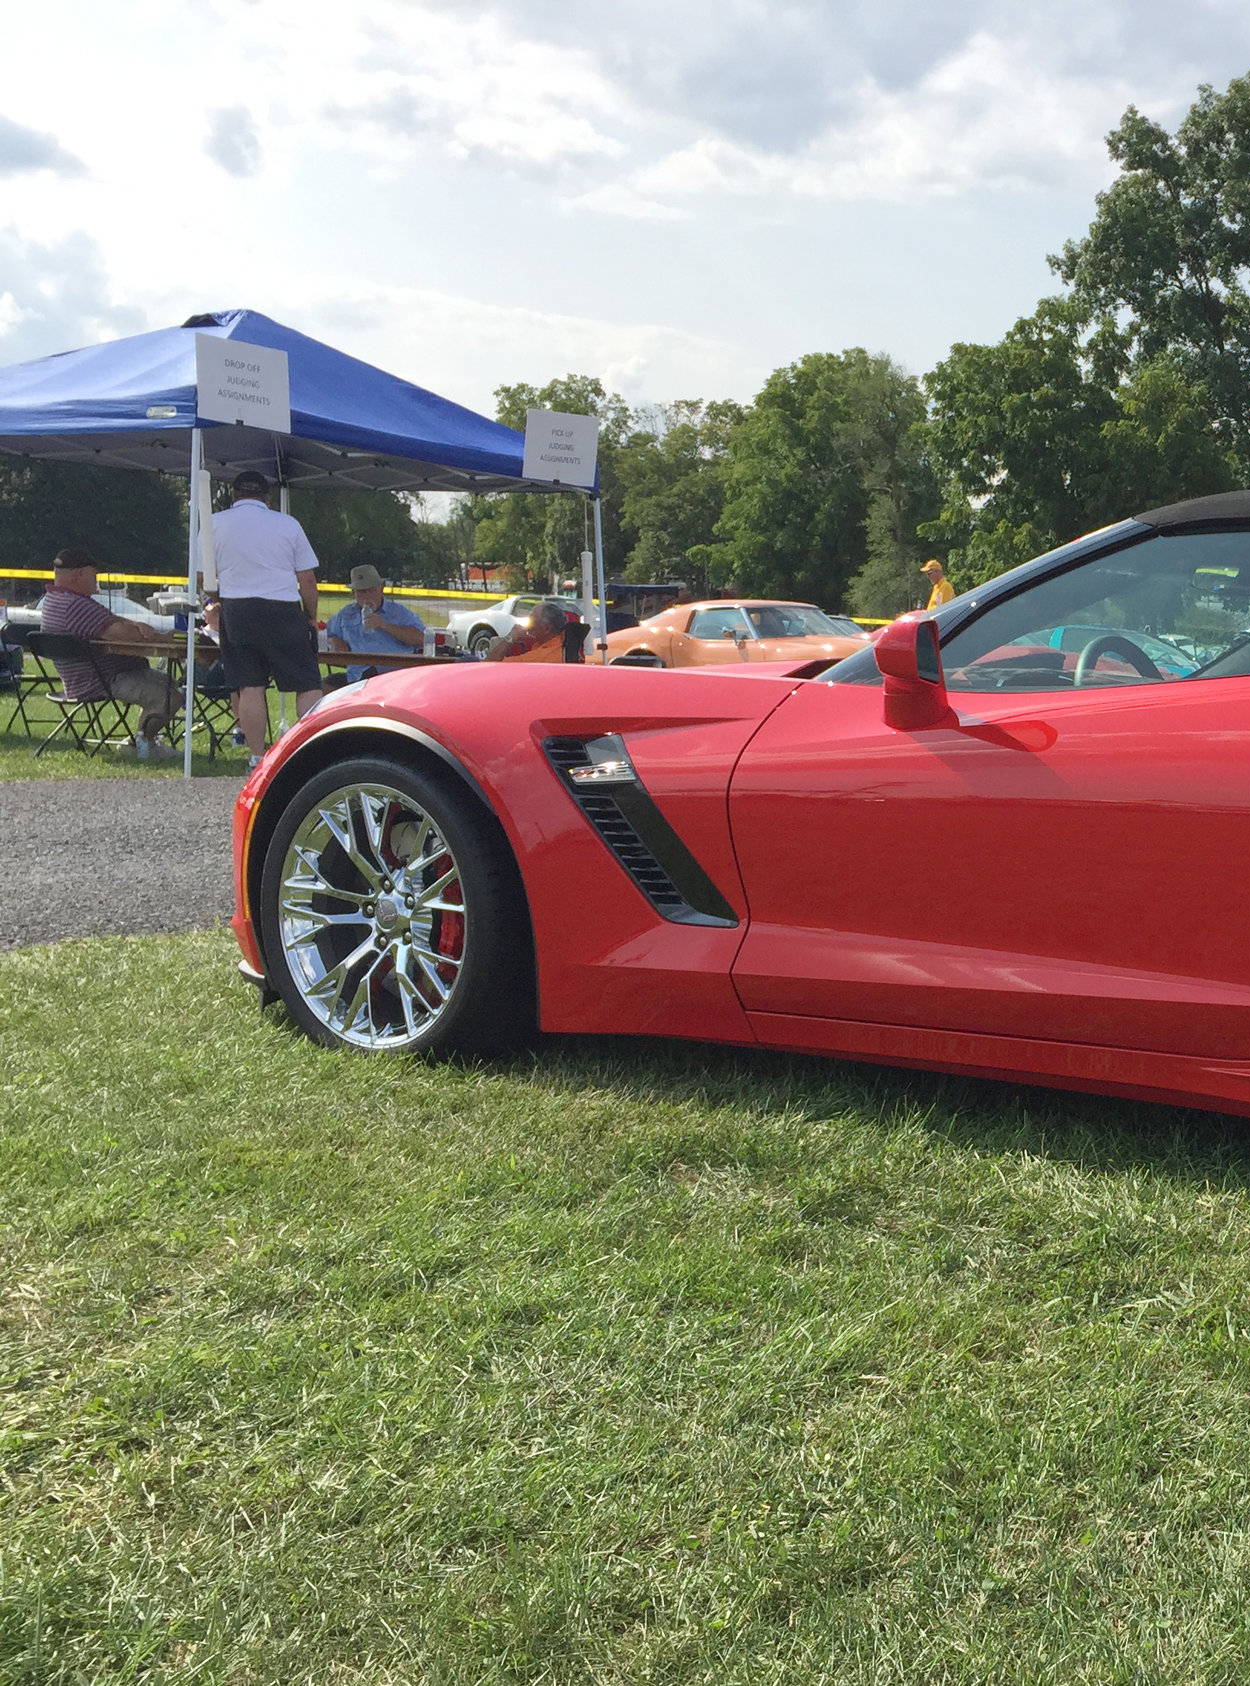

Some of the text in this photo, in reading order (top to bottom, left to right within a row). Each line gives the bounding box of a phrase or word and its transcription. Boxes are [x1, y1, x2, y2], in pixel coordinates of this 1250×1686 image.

[224, 359, 261, 373] DROP OFF
[227, 376, 260, 389] JUDGING
[217, 389, 271, 406] ASSIGNMENTS
[548, 443, 575, 452] JUDGING
